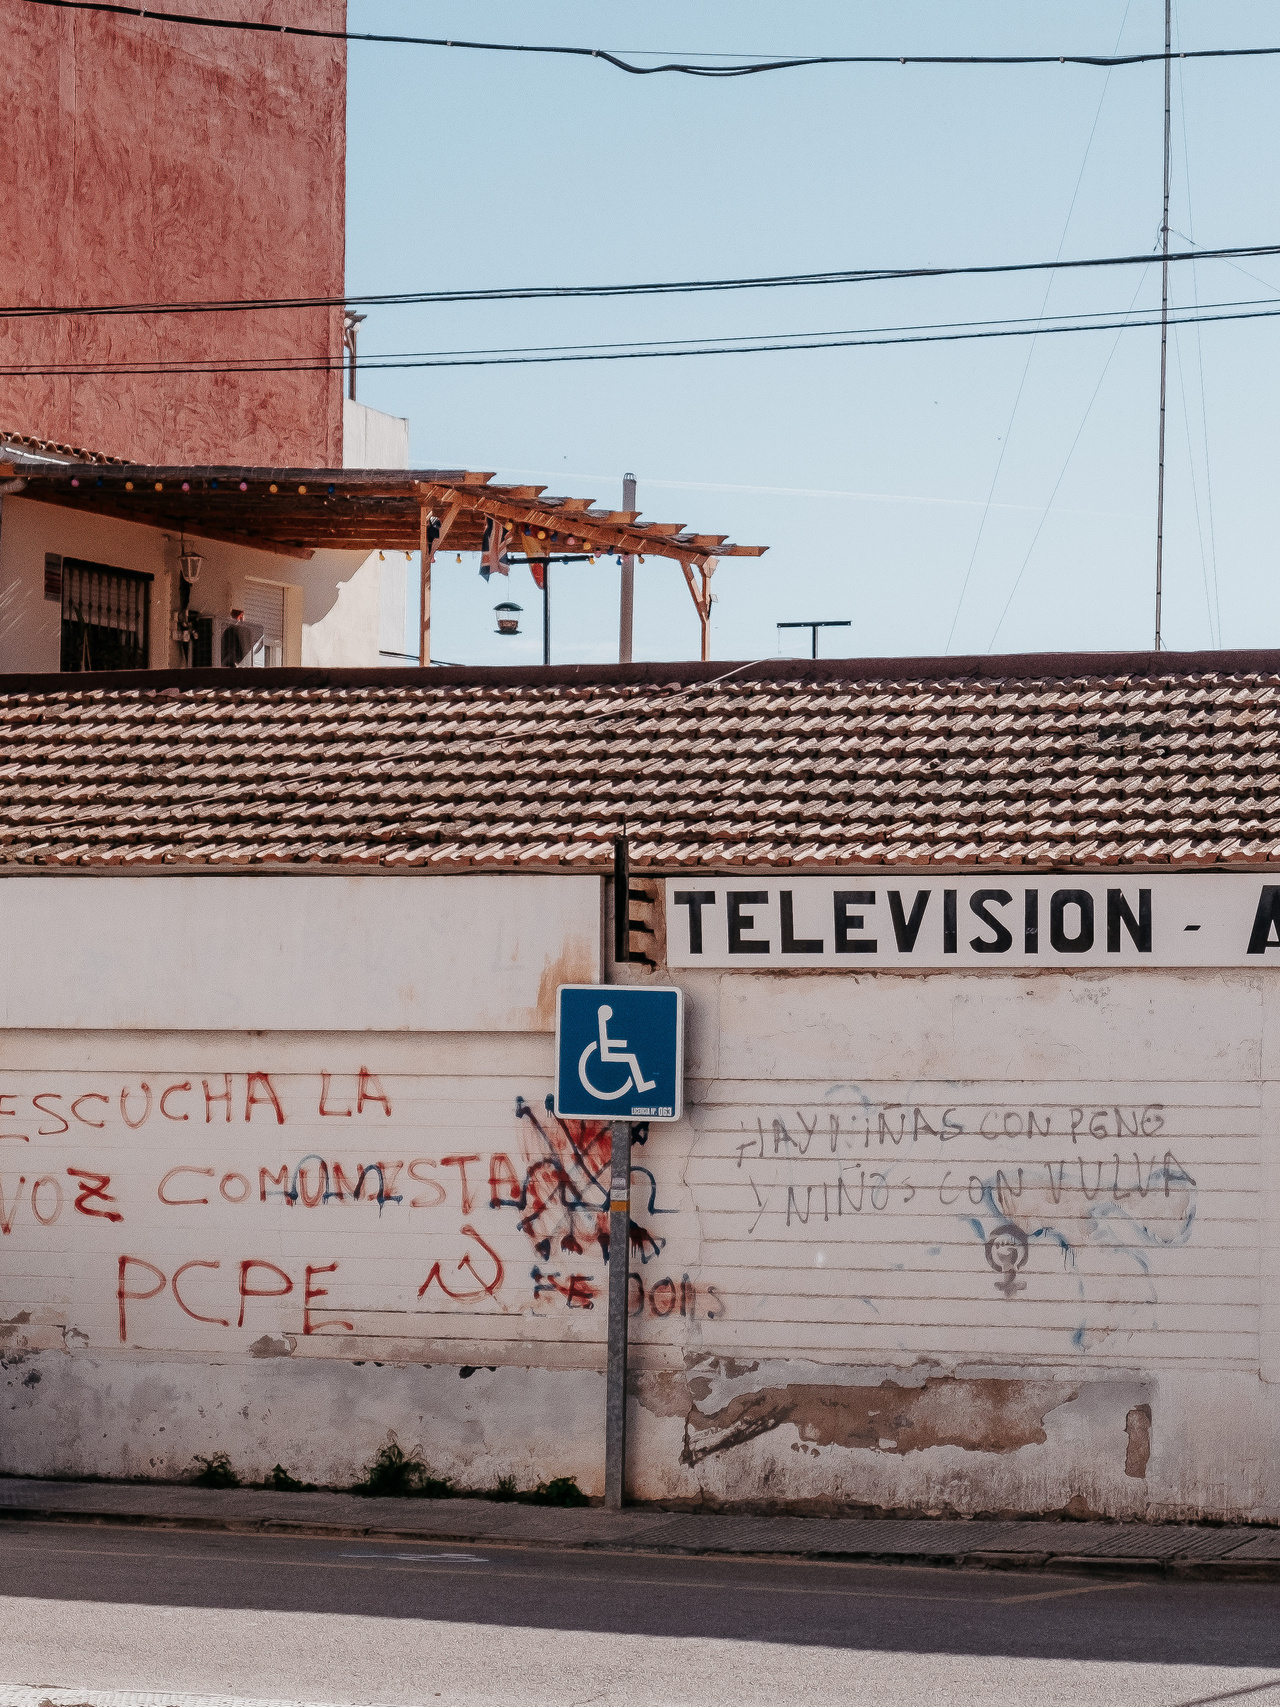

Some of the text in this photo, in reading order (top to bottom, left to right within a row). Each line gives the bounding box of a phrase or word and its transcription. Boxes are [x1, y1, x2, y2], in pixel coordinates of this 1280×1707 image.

[673, 887, 1153, 955] TELEVISION
[319, 1066, 392, 1117] LA
[980, 1109, 1051, 1140] CON
[939, 1167, 1025, 1204] CON
[1043, 1149, 1197, 1205] VULVA
[117, 1255, 353, 1342] PCPE
